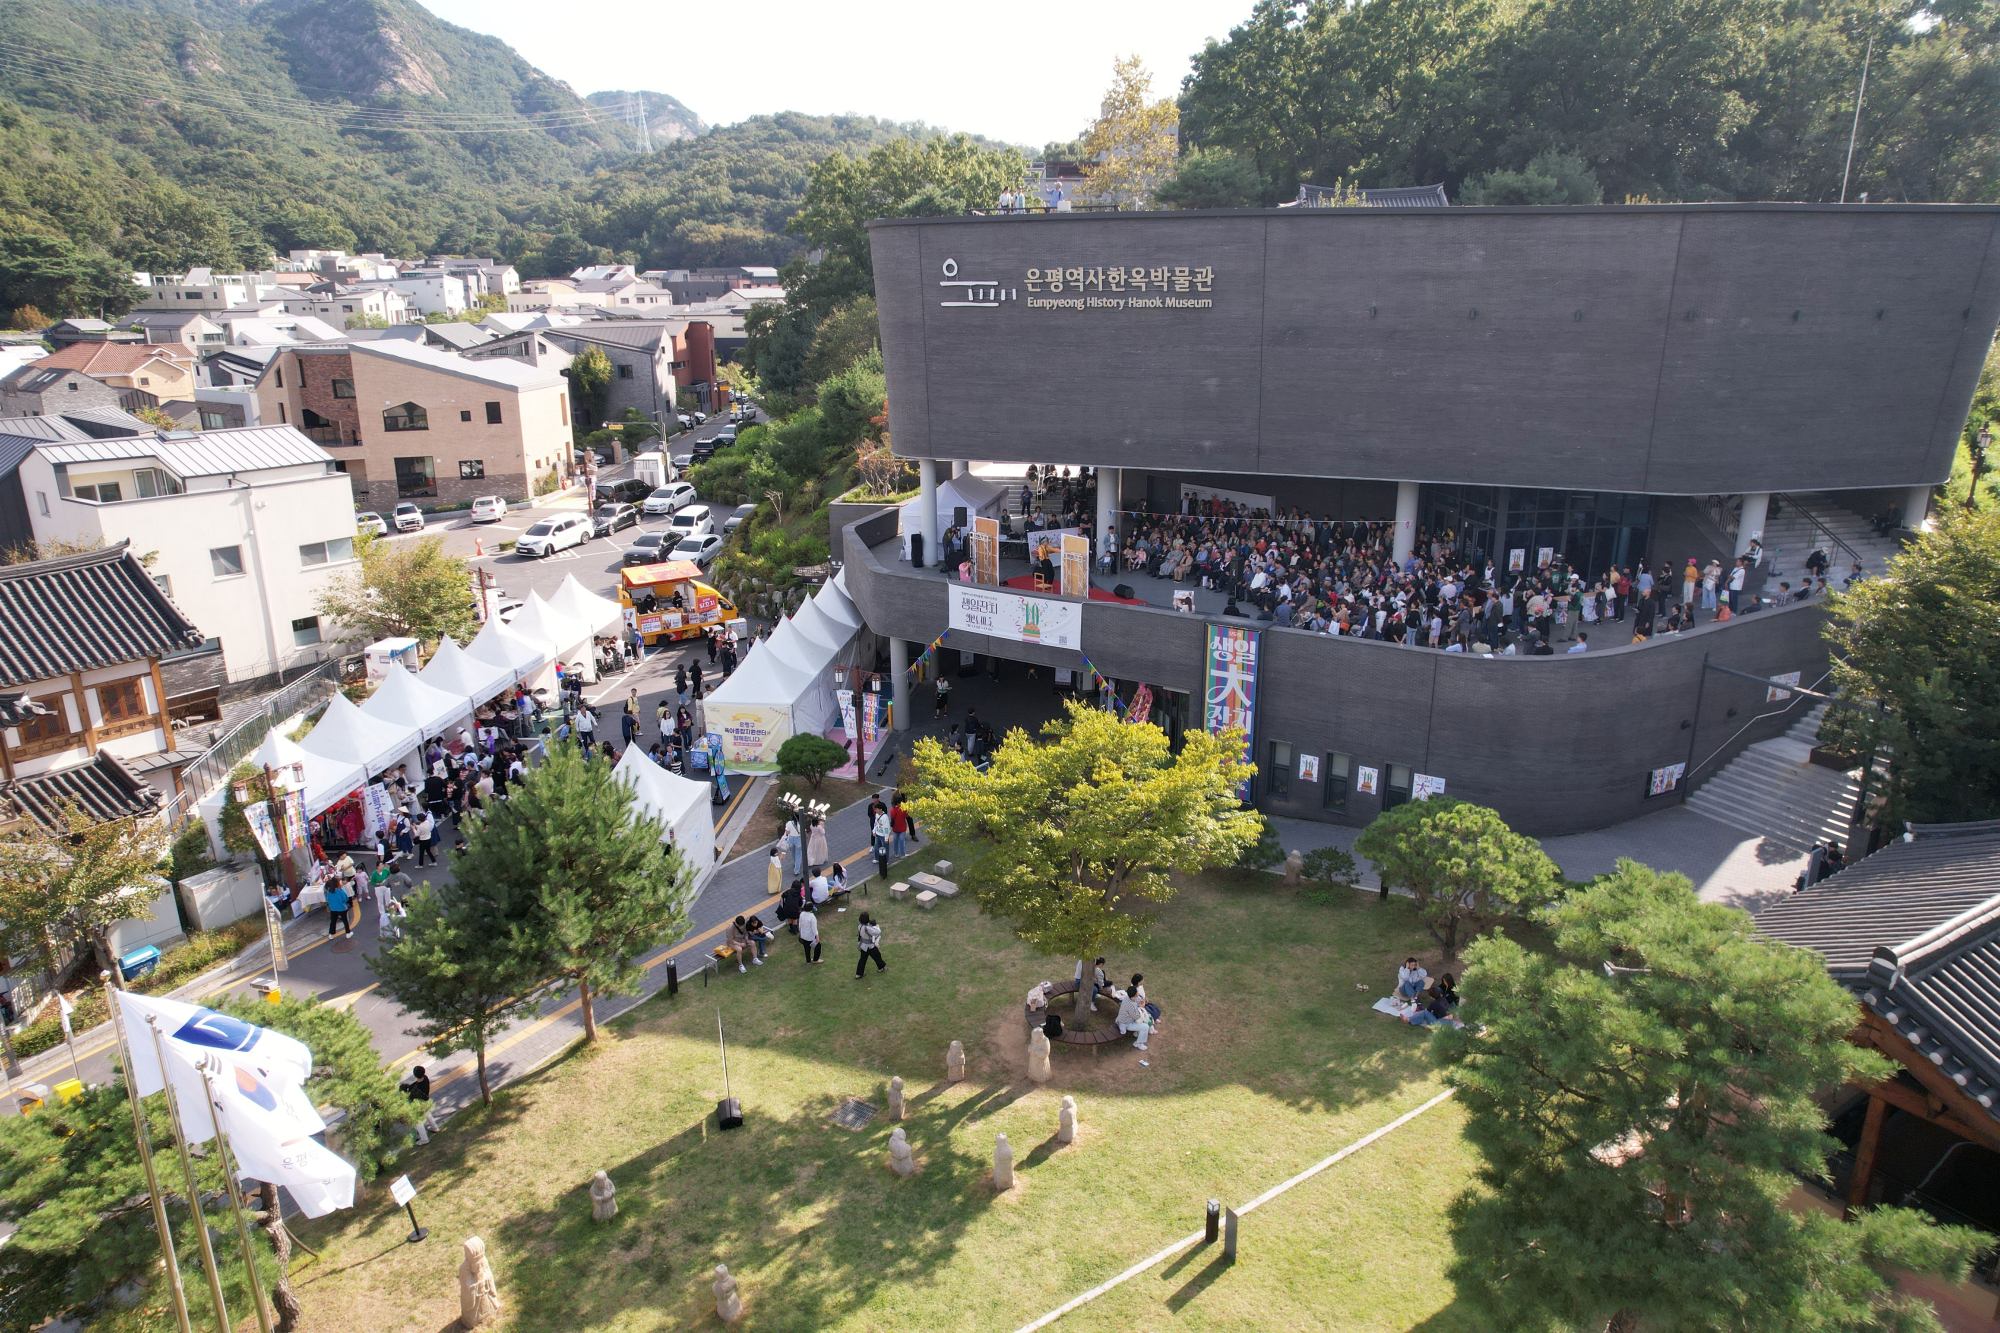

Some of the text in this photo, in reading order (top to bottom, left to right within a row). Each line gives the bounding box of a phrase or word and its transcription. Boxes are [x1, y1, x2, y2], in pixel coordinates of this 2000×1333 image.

[1023, 266, 1214, 292] 은평역사한옥박물관
[1027, 297, 1213, 310] Eunpyeong History Hanok Museum
[961, 597, 998, 615] 생일잔치
[1210, 636, 1256, 665] 생일
